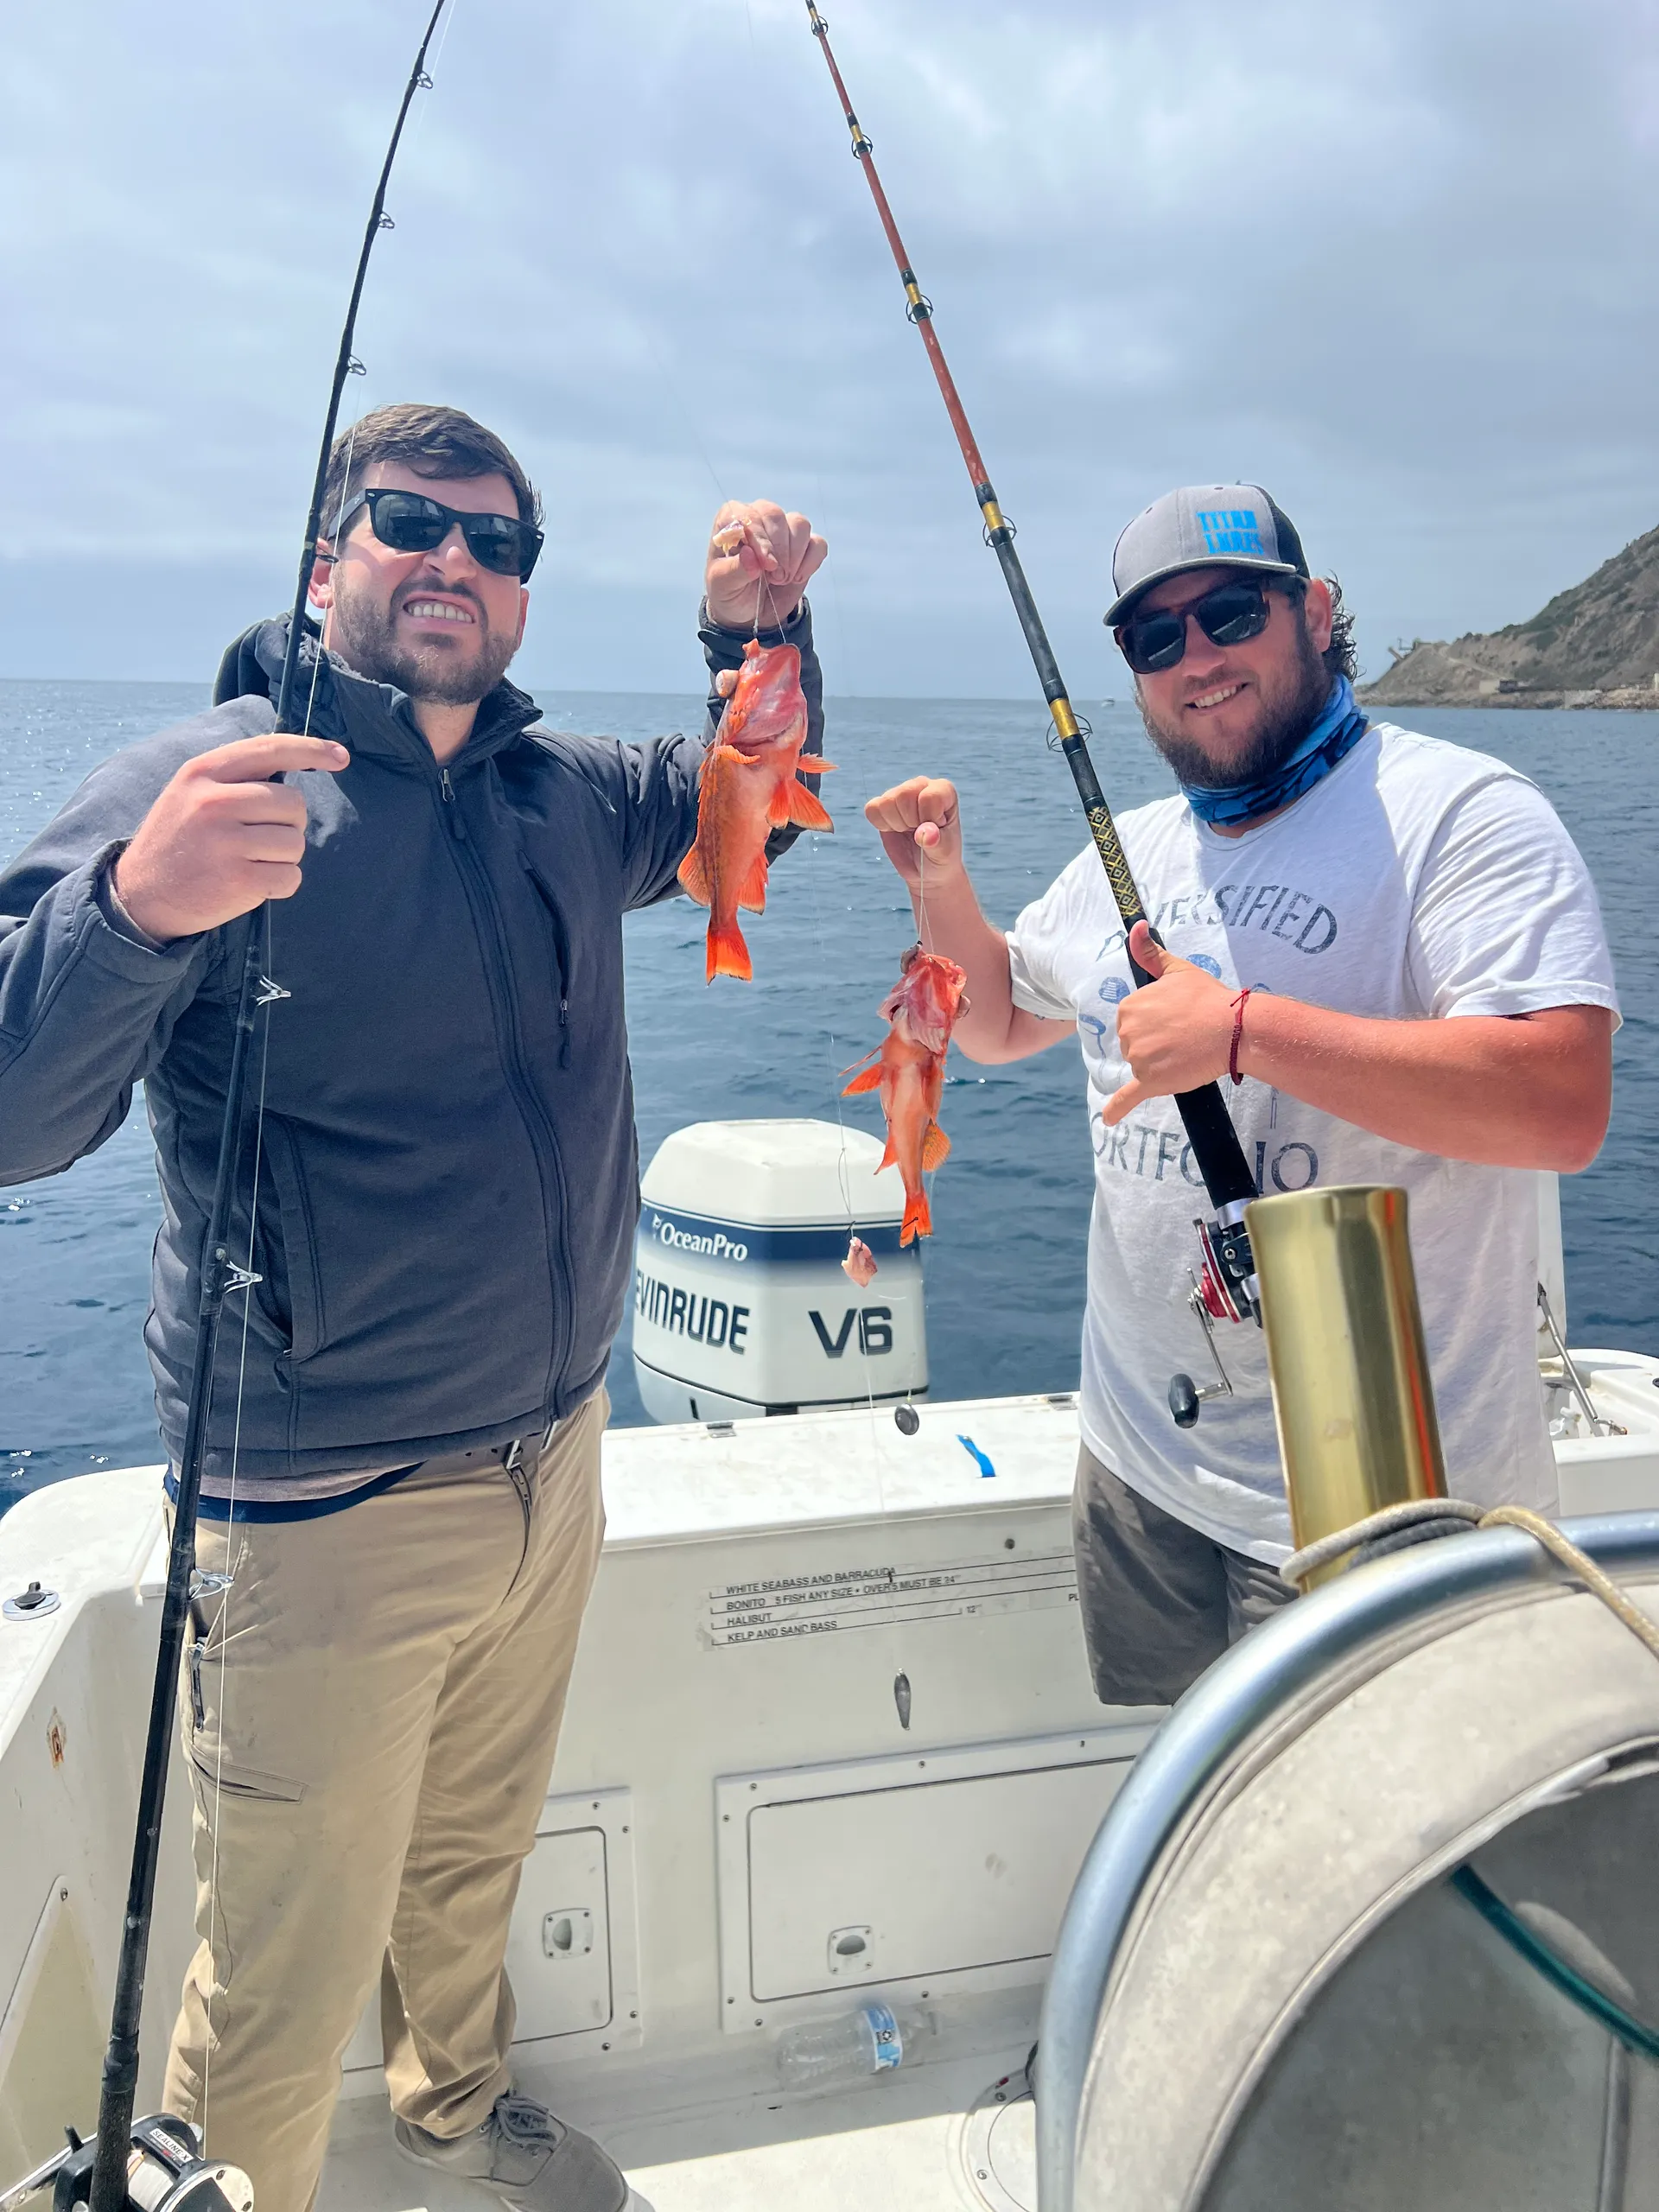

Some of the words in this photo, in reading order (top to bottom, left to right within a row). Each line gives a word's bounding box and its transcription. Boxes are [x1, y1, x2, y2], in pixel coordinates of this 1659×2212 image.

[1090, 1111, 1319, 1195] ORTFOIO
[660, 1222, 748, 1262] OceanPro
[808, 1306, 893, 1359] V6
[727, 1583, 760, 1594] WHITE
[761, 1577, 810, 1592] SEABASS
[811, 1574, 833, 1584] AND
[835, 1567, 896, 1582] BARRACUDA
[727, 1598, 766, 1610] BONITO
[783, 1593, 806, 1604] FISH
[808, 1590, 830, 1600] ANY
[830, 1586, 854, 1598] SIZE
[863, 1583, 891, 1594] OVER
[899, 1579, 927, 1590] MUST
[929, 1577, 942, 1586] BE
[727, 1630, 755, 1643] KELP
[757, 1628, 779, 1639] AND
[810, 1620, 838, 1632] BASS
[728, 1612, 772, 1626] HALIBUT
